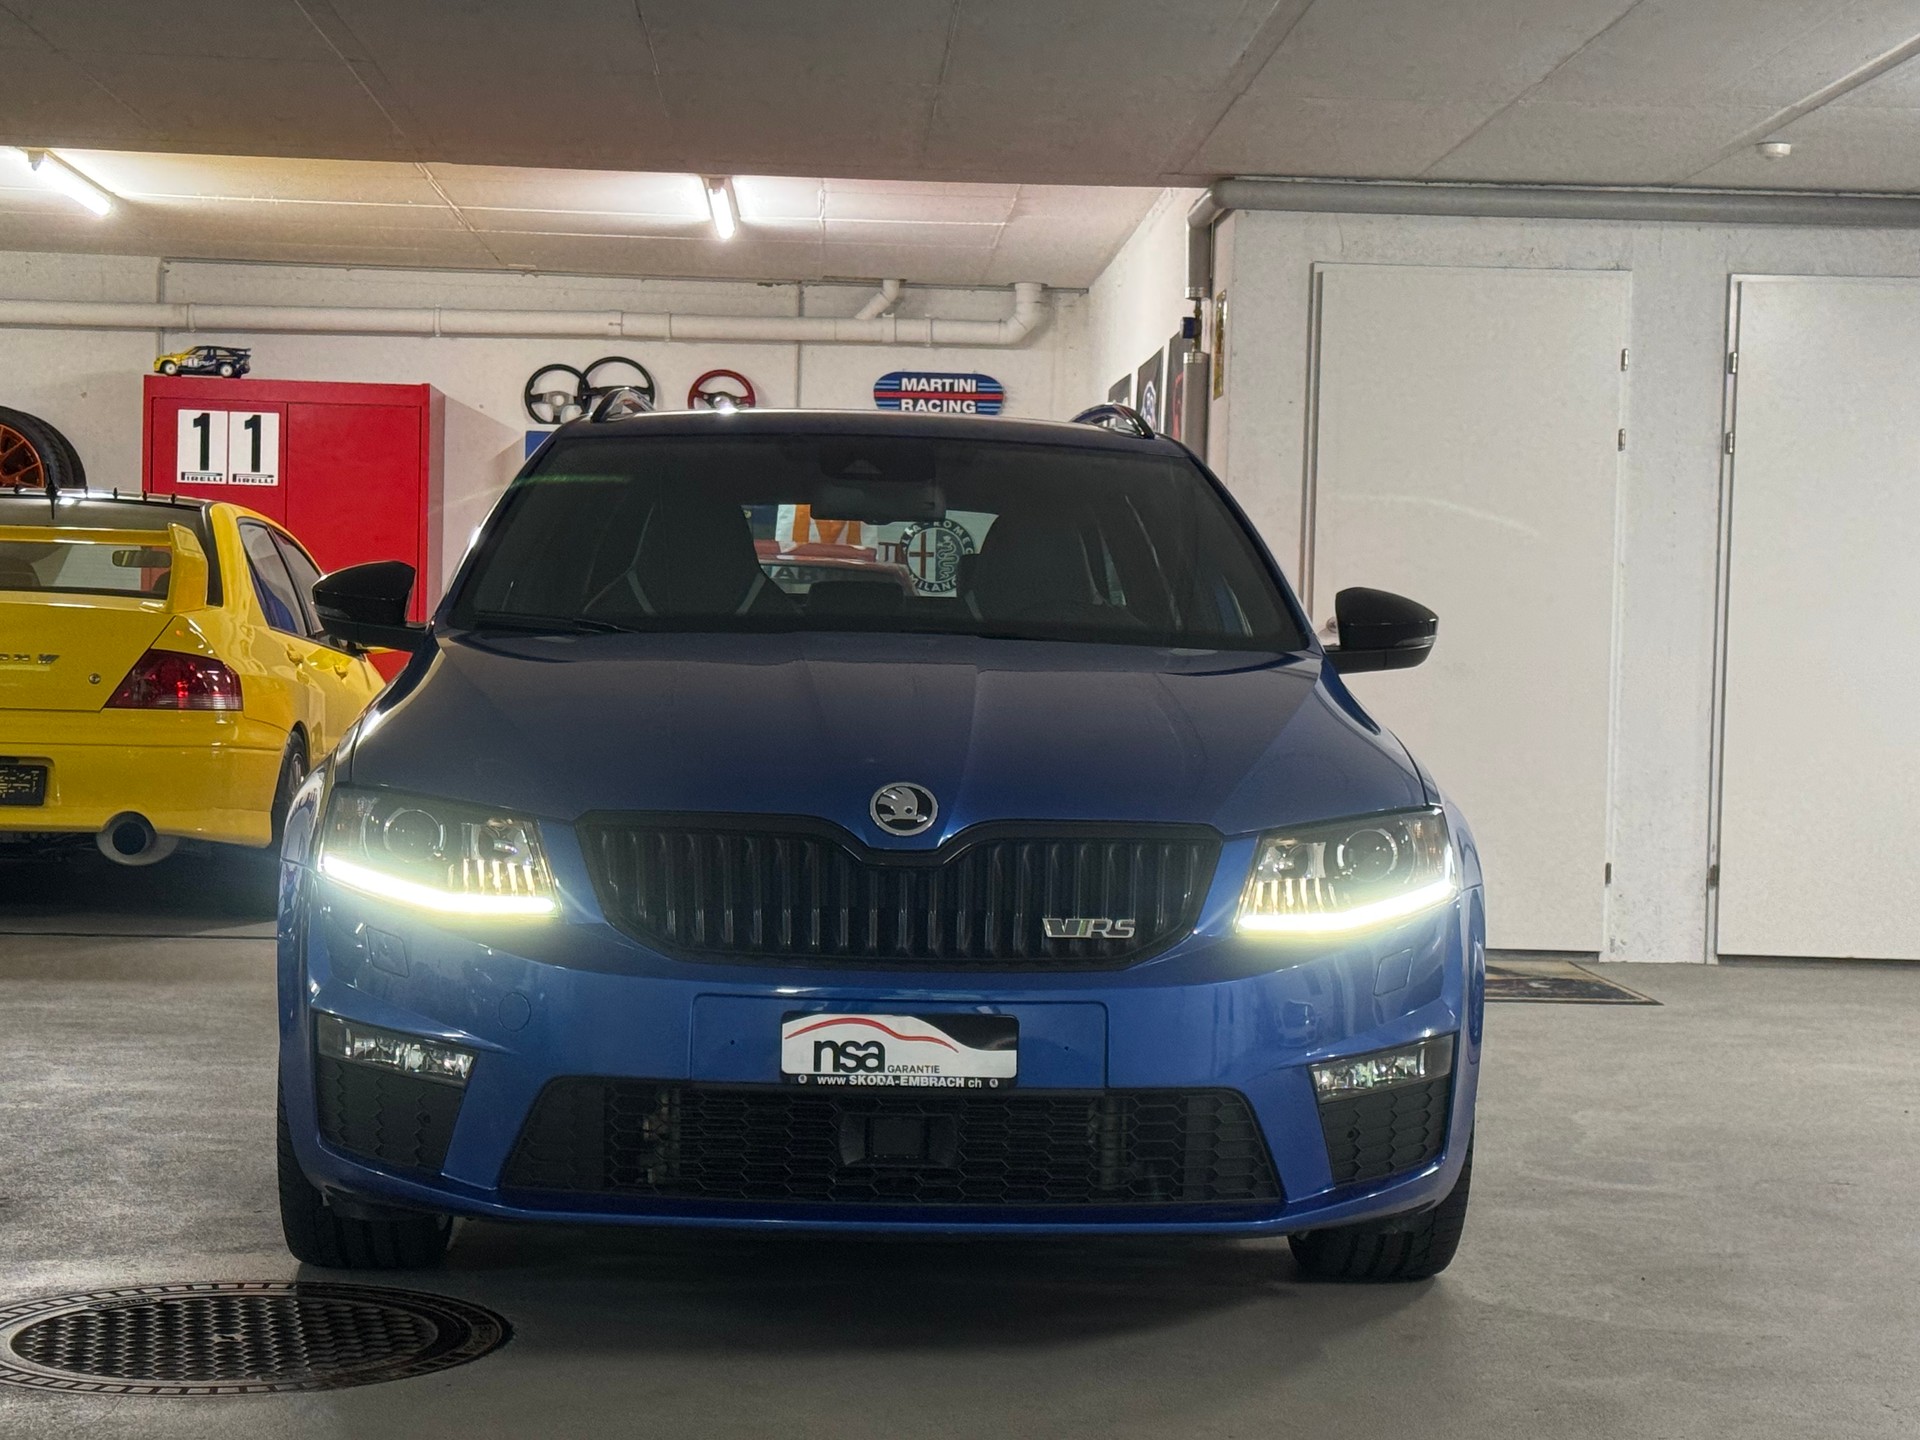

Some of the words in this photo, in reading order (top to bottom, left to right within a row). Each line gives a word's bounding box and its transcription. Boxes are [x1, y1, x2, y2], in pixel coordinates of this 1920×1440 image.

[901, 377, 976, 393] MARTINI
[901, 398, 976, 414] RACING
[181, 471, 223, 482] PIRELLI
[232, 473, 274, 484] PIRELLI
[813, 1039, 886, 1074] nsa
[887, 1064, 941, 1074] GARANTIE
